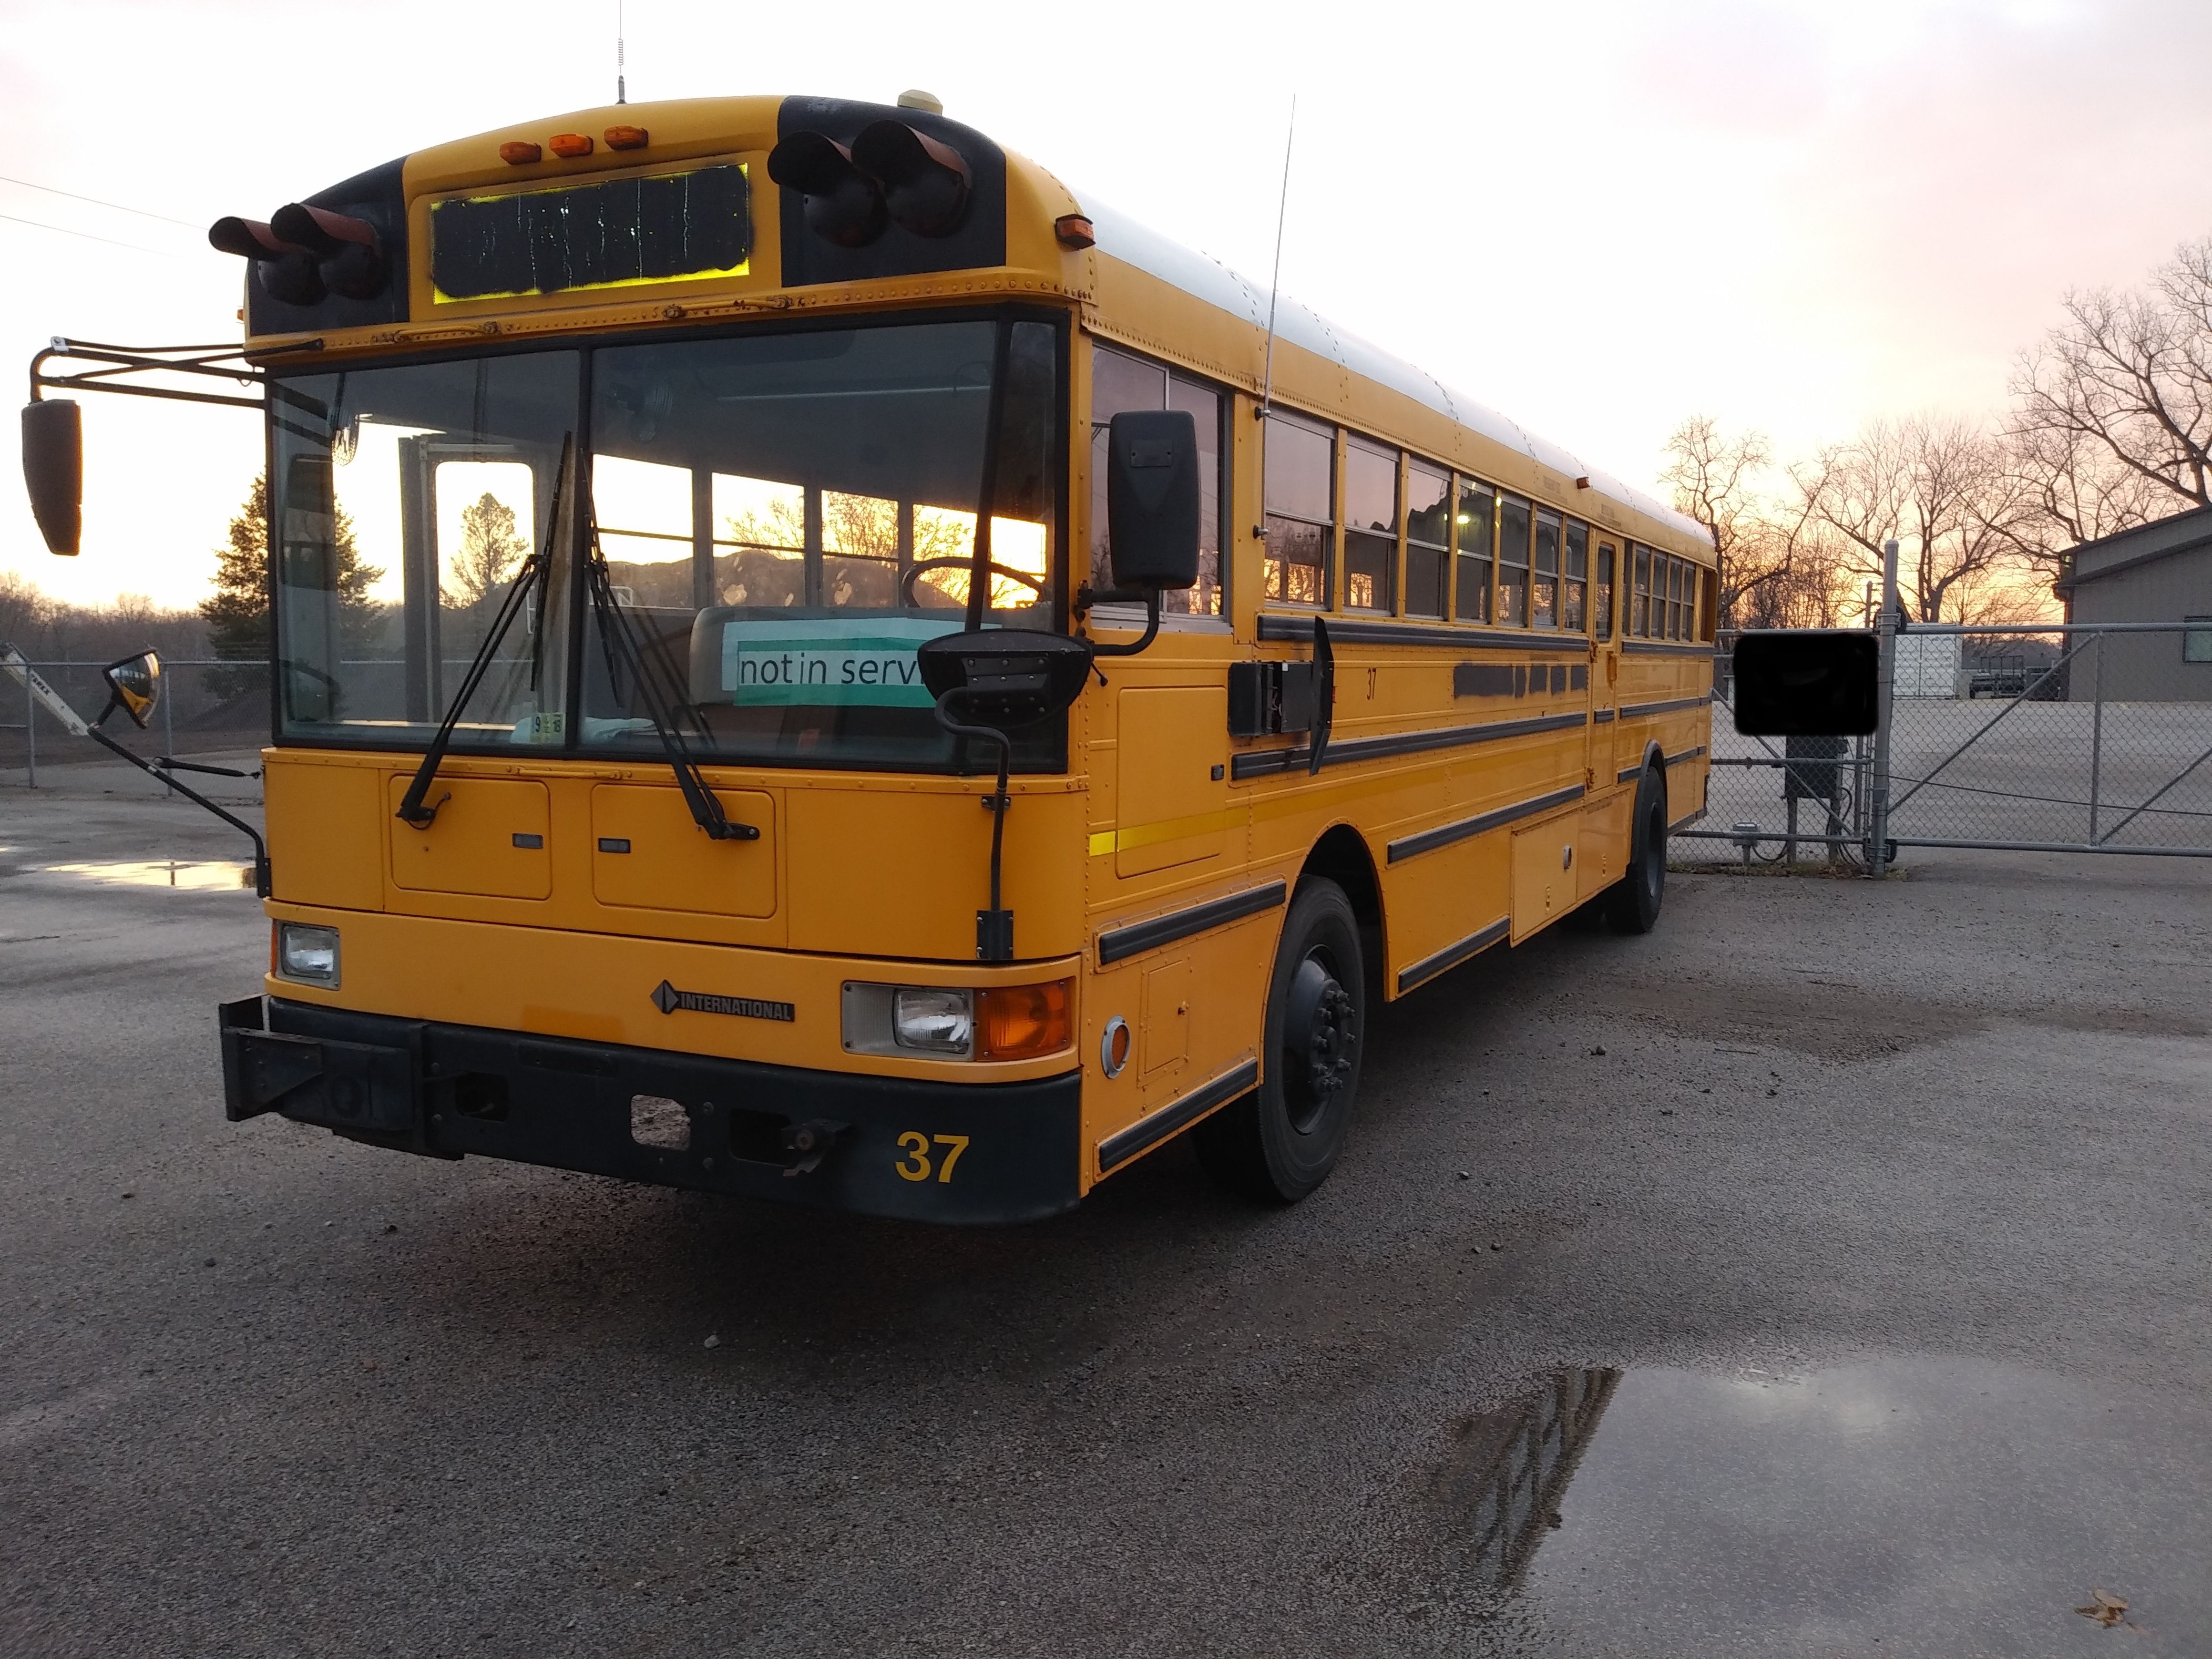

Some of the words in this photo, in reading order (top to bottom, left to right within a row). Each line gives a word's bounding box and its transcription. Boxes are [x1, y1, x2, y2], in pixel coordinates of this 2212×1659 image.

[740, 654, 793, 684] not
[799, 652, 827, 684] in
[841, 659, 924, 684] serv
[1366, 667, 1377, 701] 37
[680, 993, 791, 1021] INTERNATIONAL
[895, 1131, 970, 1183] 37
